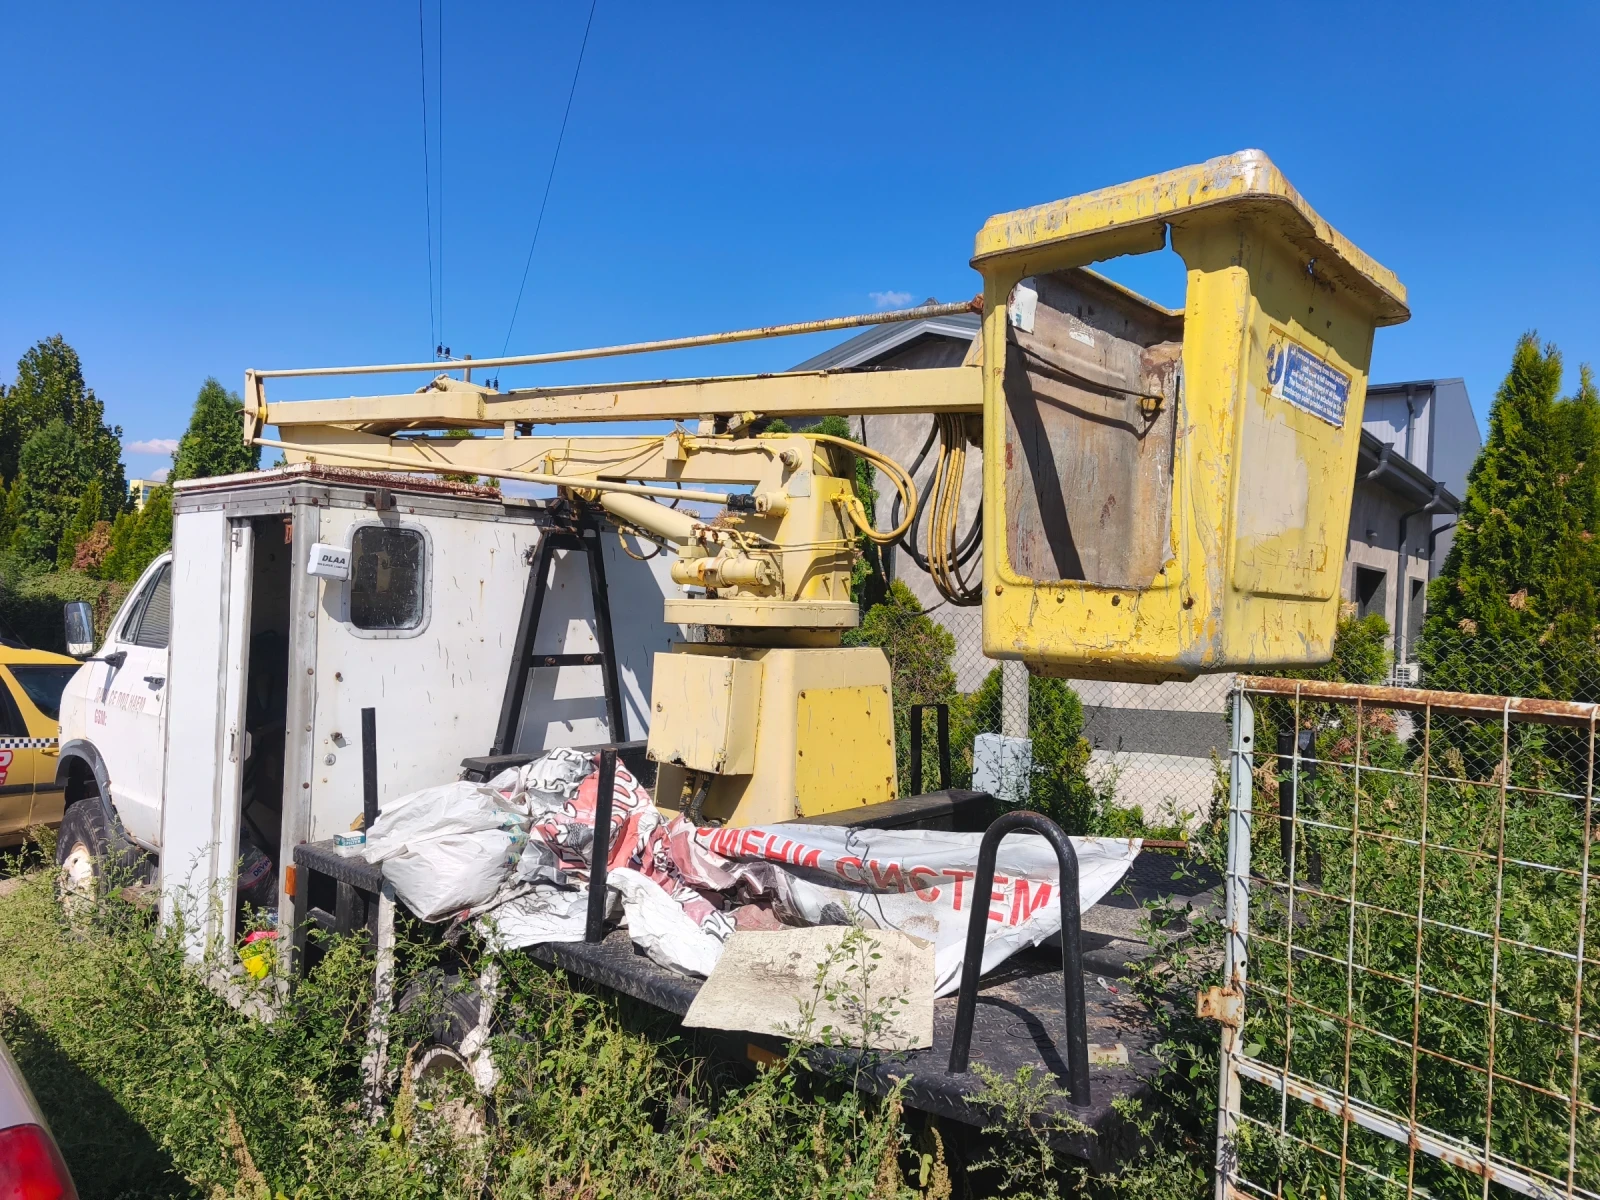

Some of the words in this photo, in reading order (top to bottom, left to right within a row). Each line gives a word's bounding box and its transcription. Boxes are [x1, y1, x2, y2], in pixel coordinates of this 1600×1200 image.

[322, 555, 345, 564] DLAA
[253, 858, 270, 877] DEVIN
[836, 857, 1061, 926] СИСТЕМ
